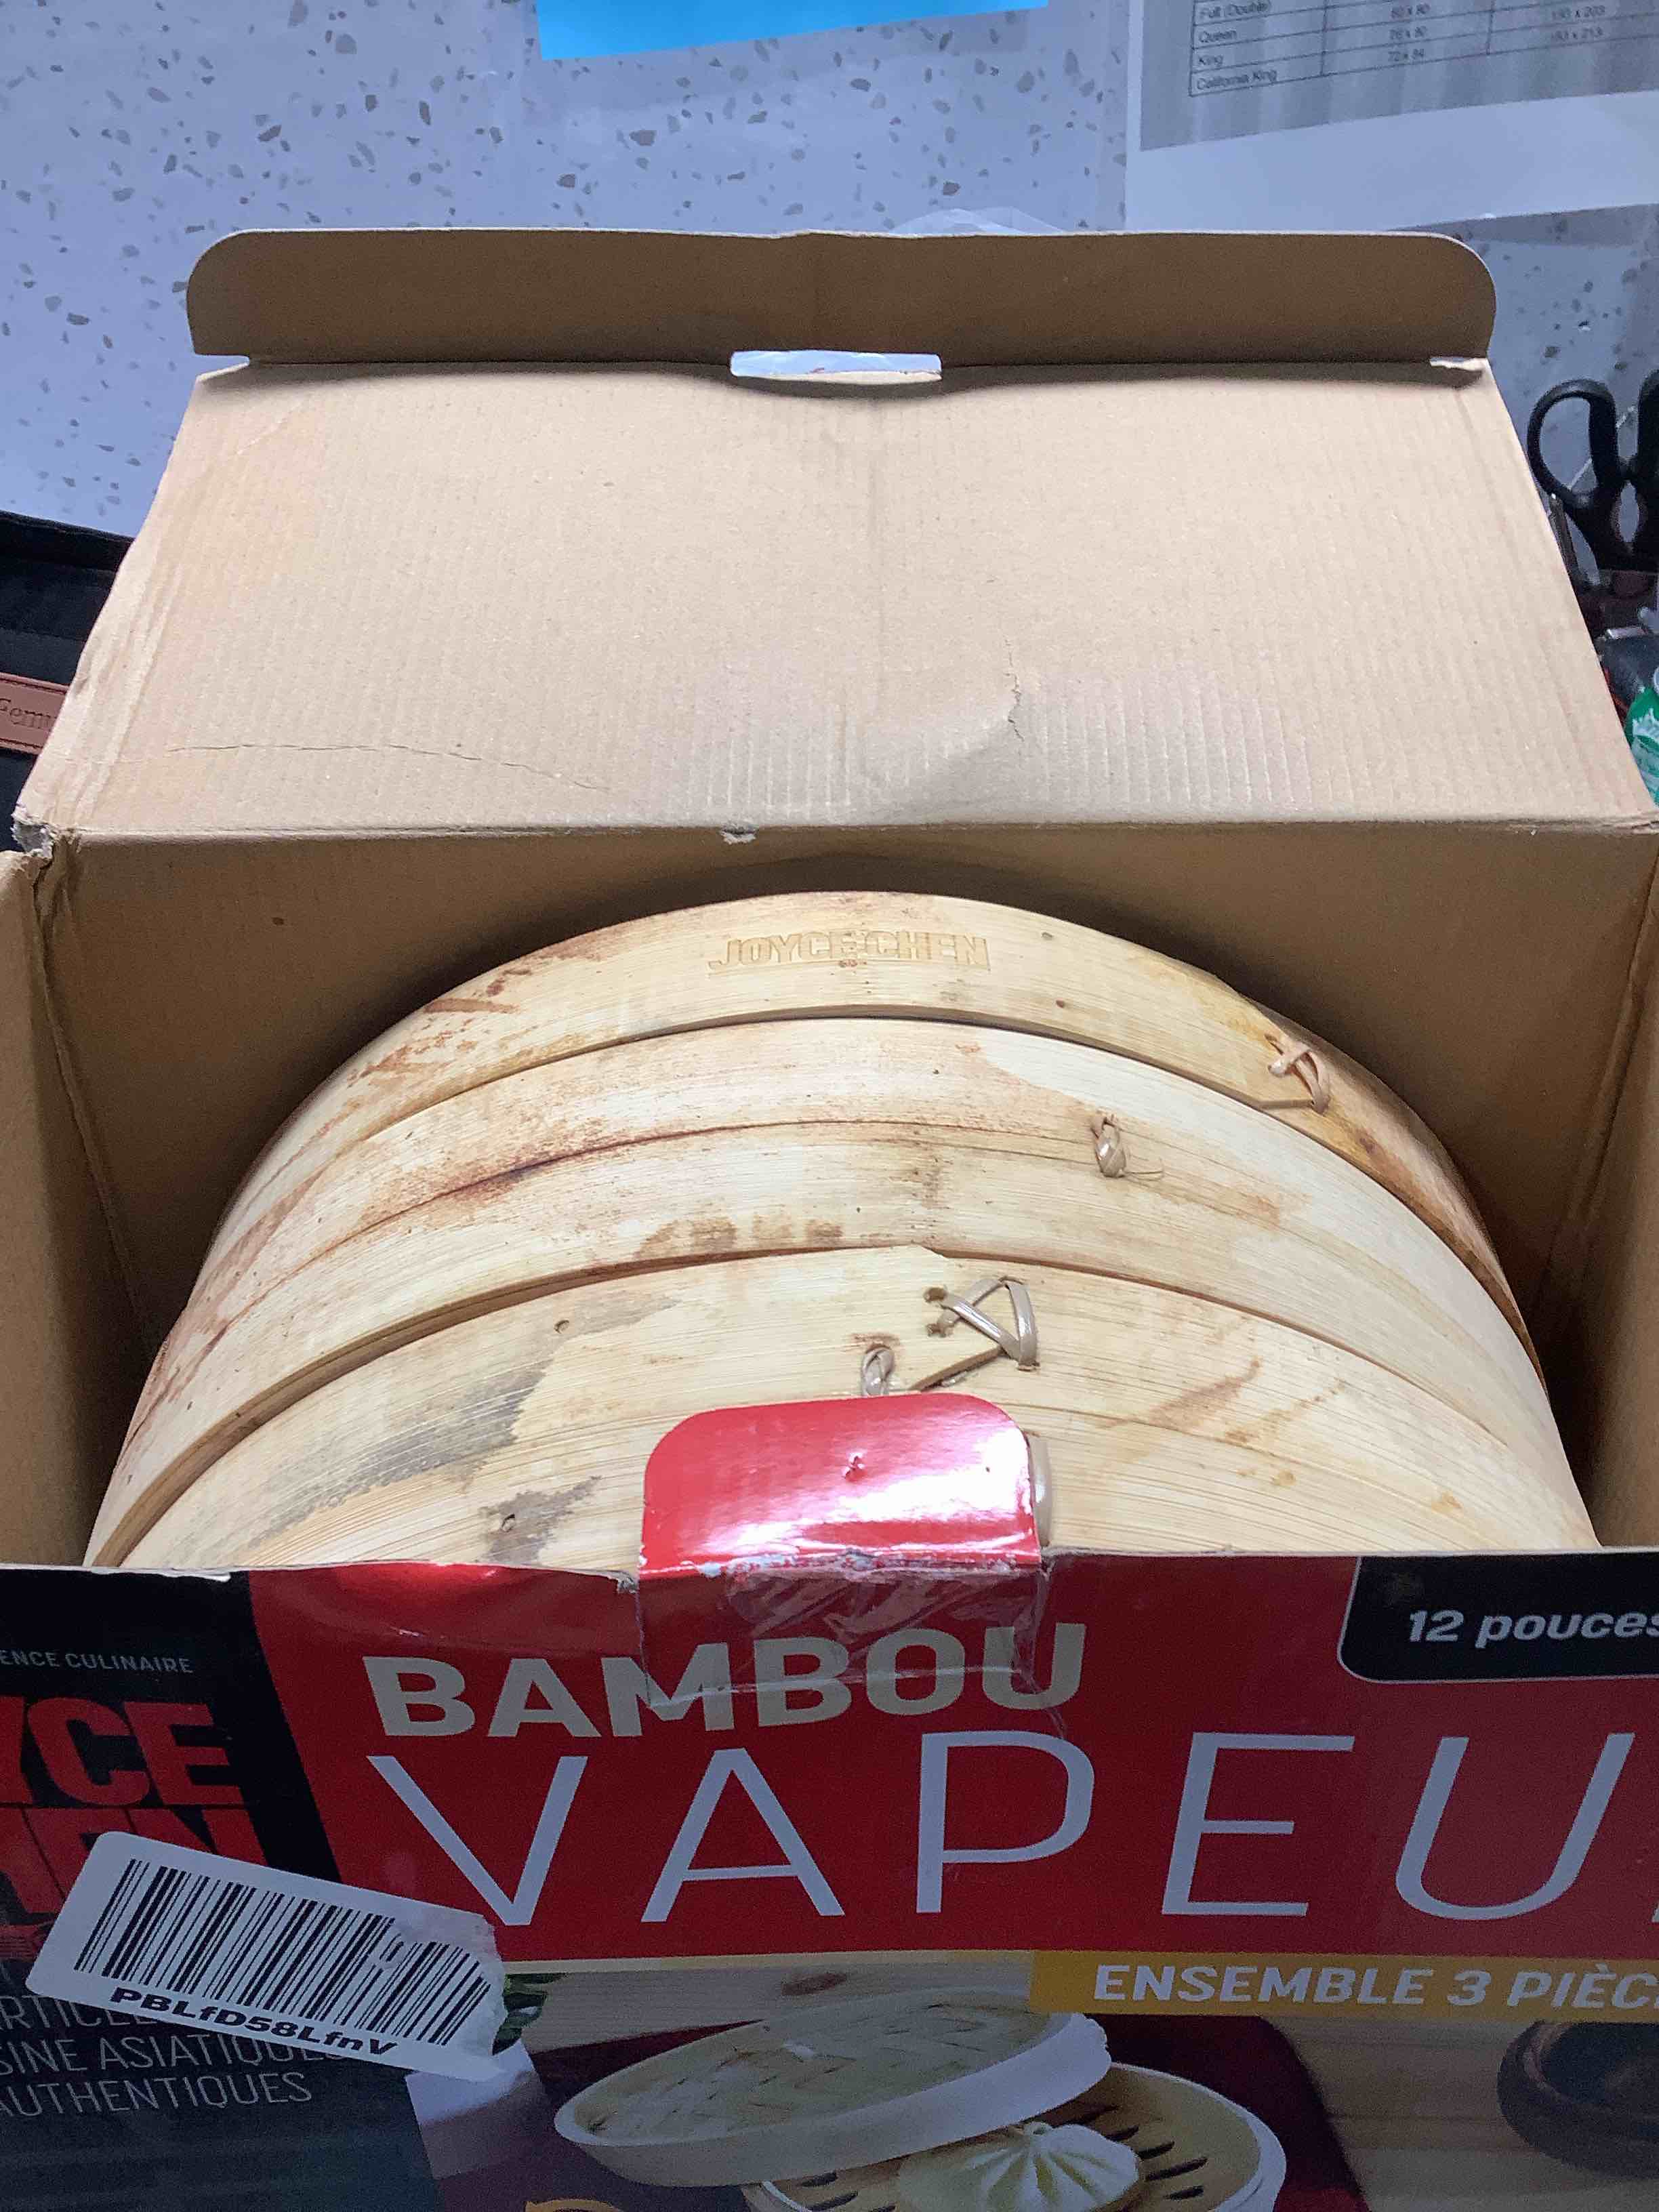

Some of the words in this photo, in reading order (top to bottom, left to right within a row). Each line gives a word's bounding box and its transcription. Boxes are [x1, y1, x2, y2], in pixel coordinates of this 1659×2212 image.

[1197, 30, 1237, 43] Queen
[708, 930, 856, 975] JOYCE
[865, 930, 991, 970] CHEN
[1409, 1610, 1465, 1643] 12
[65, 1653, 194, 1673] CULINAIRE
[361, 1622, 1087, 1738] BAMBOU
[366, 1729, 1659, 1926] VAPEU
[1092, 1963, 1434, 2007] ENSEMBLE
[1448, 1967, 1493, 2007] 3
[1506, 1963, 1659, 2009] PIÈC
[110, 1986, 398, 2056] PBLfD58LfnV
